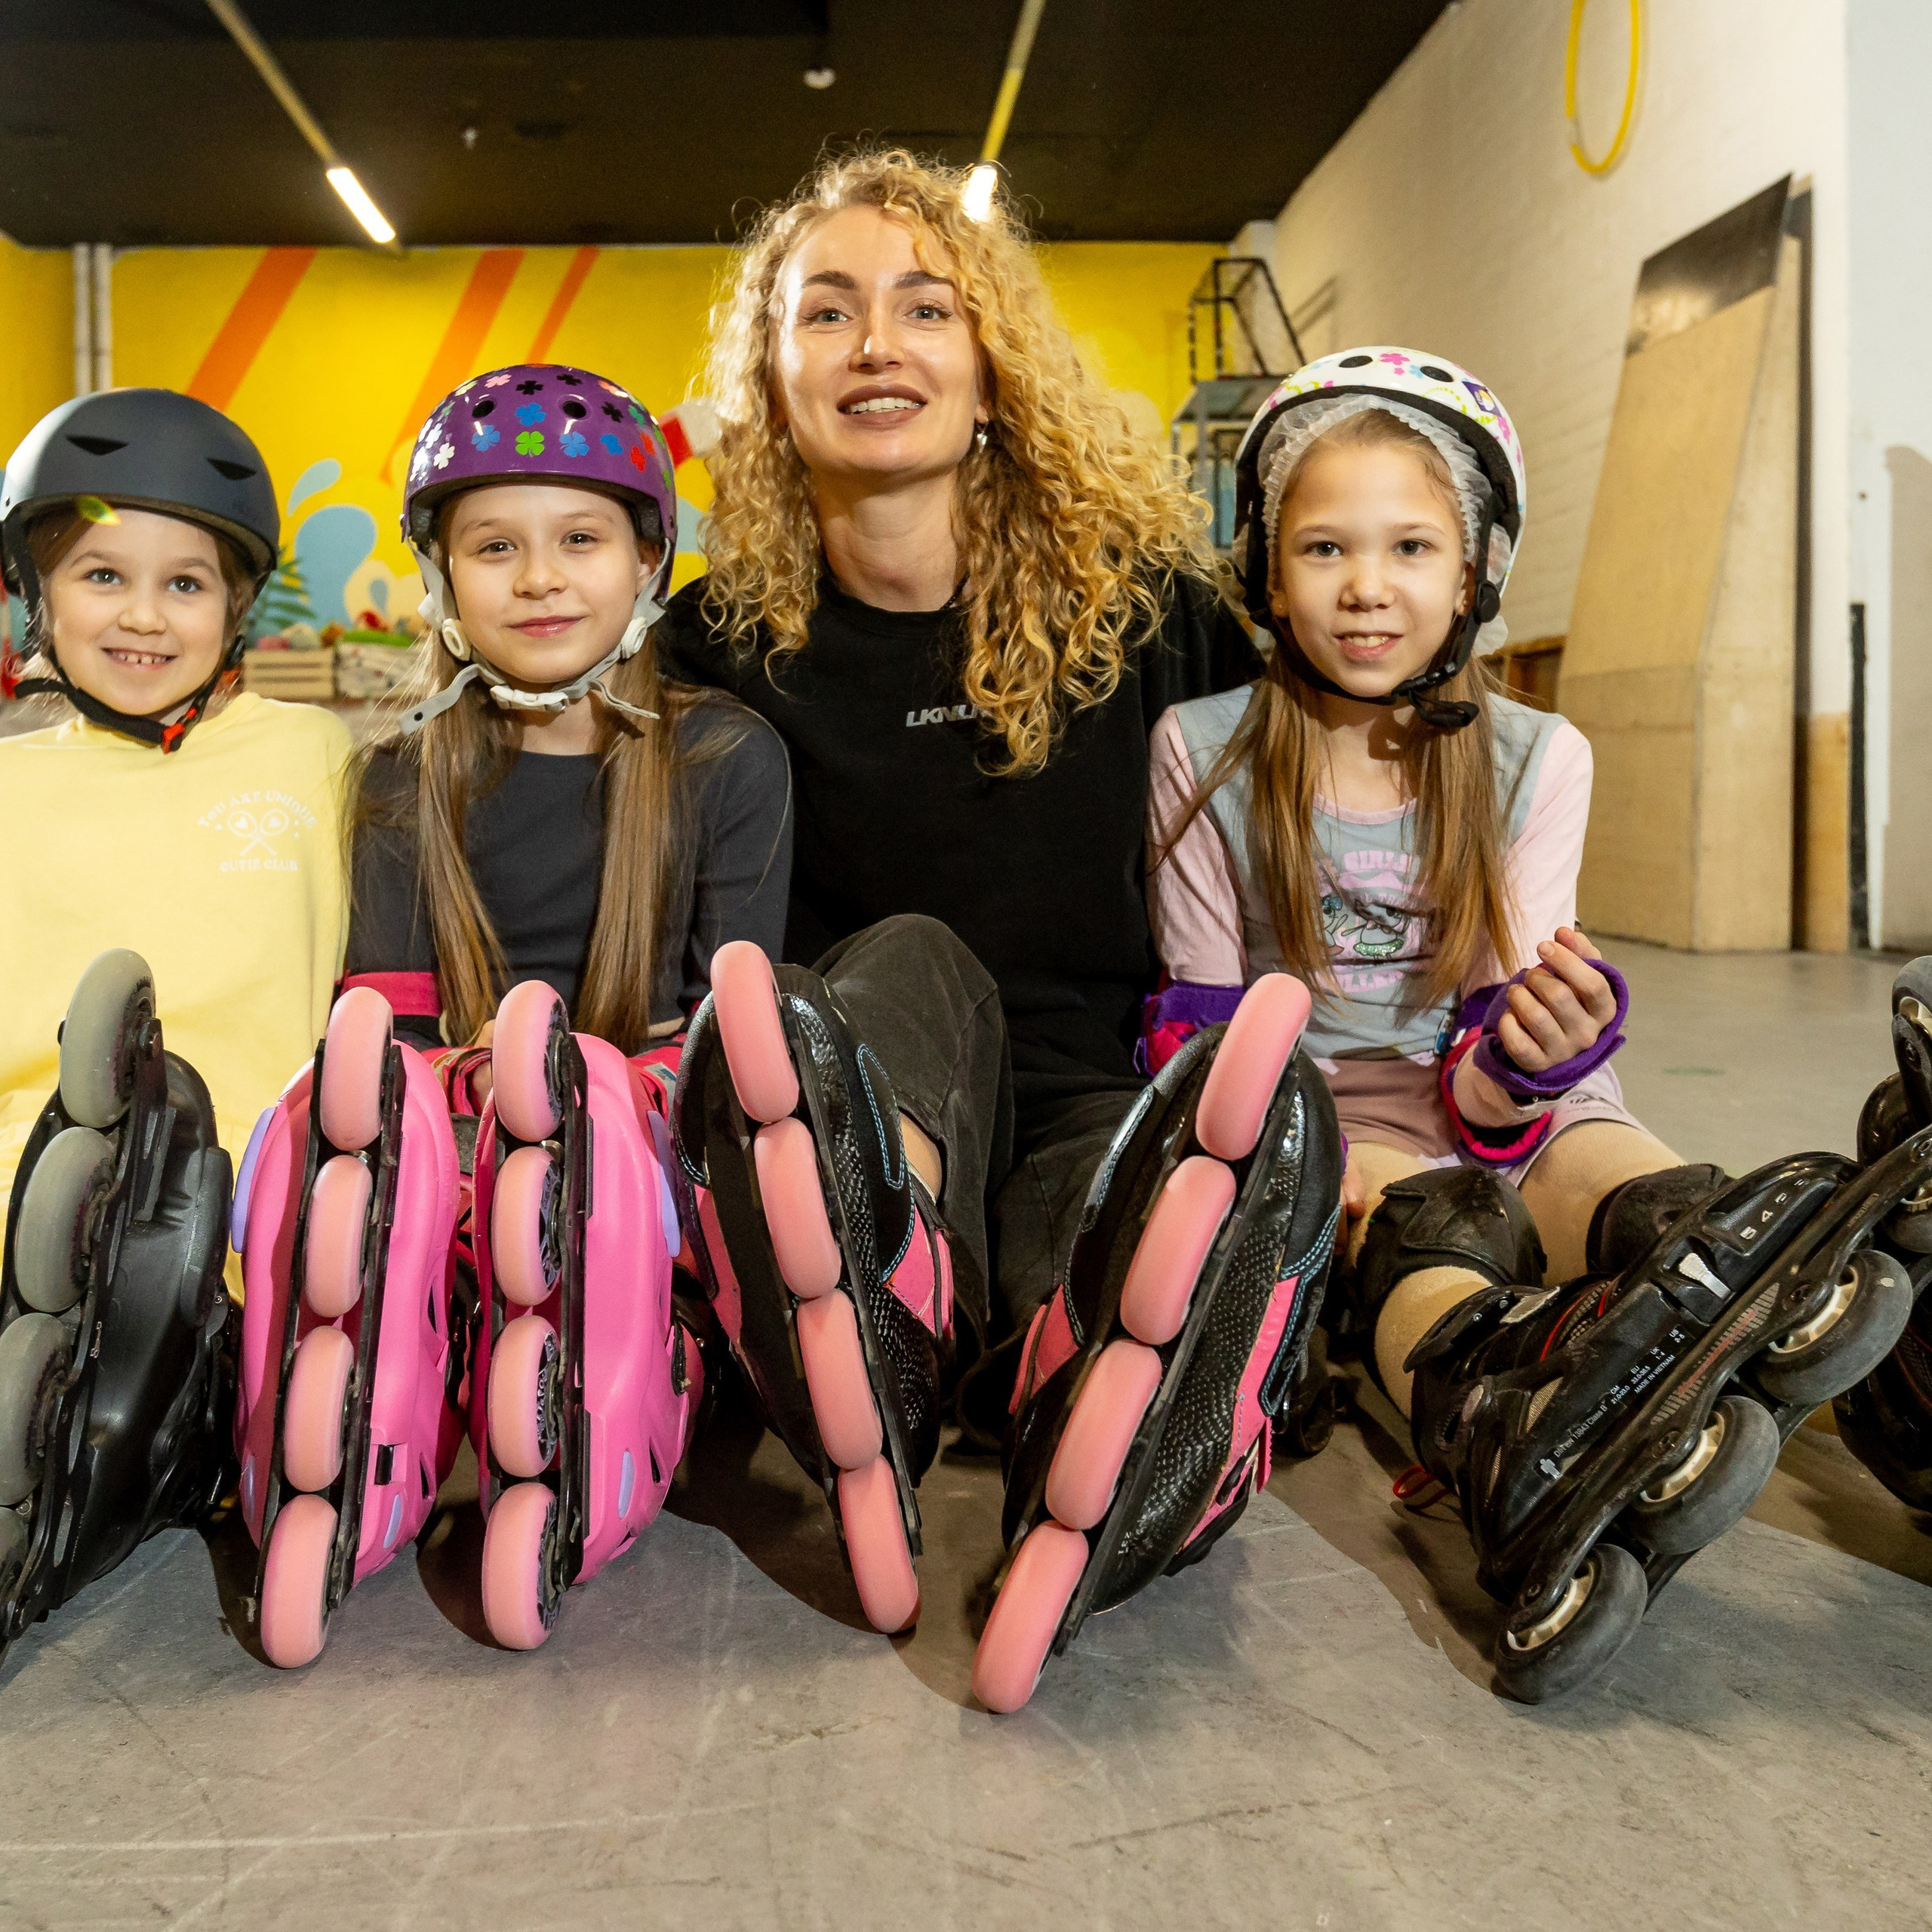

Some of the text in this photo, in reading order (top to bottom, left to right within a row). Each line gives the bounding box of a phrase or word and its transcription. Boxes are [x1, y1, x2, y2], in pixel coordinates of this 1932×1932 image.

[229, 792, 261, 808] ARE
[265, 790, 317, 828] UNIQUE
[263, 859, 298, 872] CLUB
[1740, 1226, 1758, 1240] 5
[1761, 1210, 1774, 1223] 4
[1610, 1385, 1621, 1395] CM
[1630, 1365, 1640, 1374] EU
[1669, 1329, 1679, 1337] US
[1634, 1354, 1675, 1394] MADE IN VIETNAM
[1586, 1410, 1604, 1425] Class
